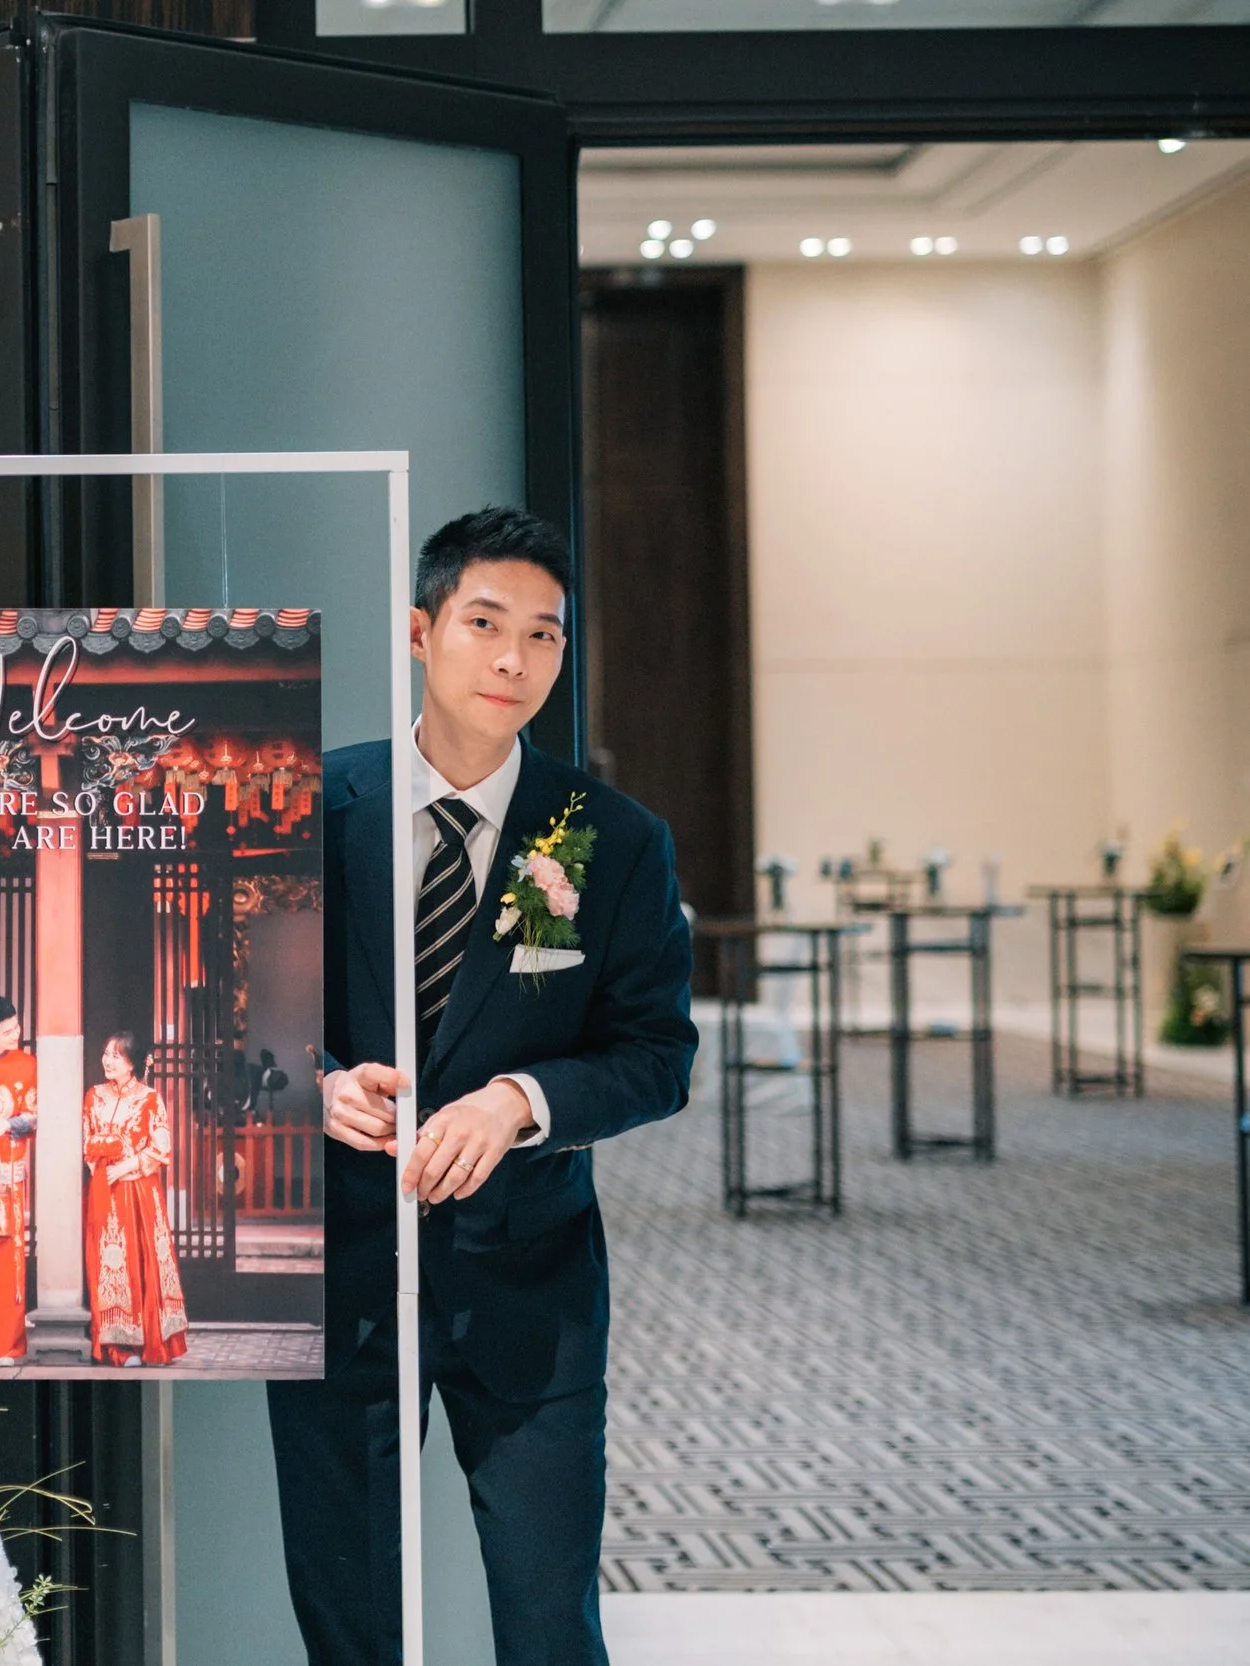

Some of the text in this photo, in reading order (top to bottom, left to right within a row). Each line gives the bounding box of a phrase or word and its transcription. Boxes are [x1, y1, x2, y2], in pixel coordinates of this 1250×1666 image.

[52, 791, 97, 816] SO
[113, 791, 206, 816] GLAD
[12, 825, 76, 850] ARE
[90, 825, 187, 850] HERE!
